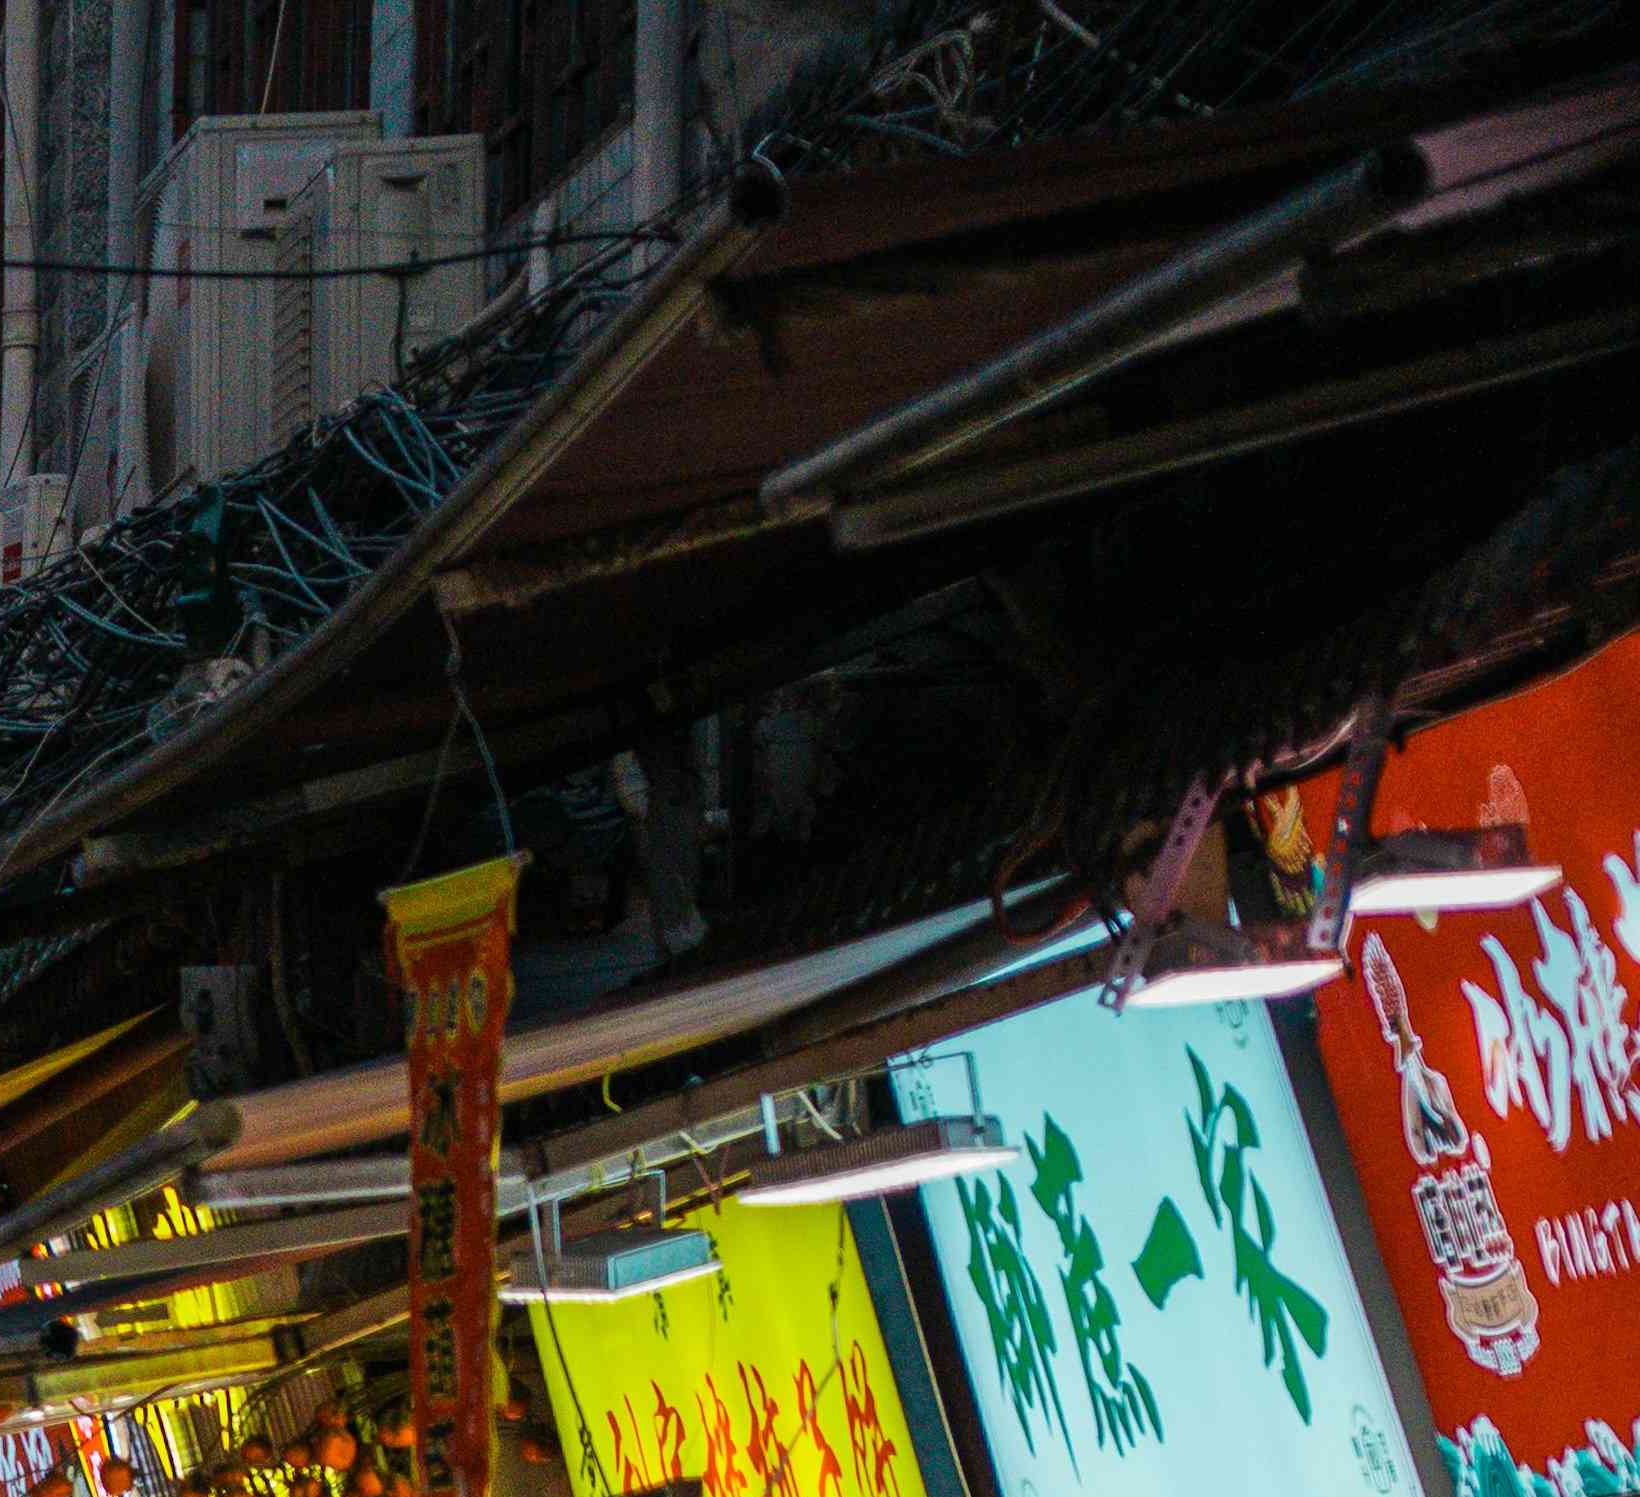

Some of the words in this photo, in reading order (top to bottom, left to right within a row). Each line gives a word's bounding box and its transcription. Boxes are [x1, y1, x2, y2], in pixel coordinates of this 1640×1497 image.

[956, 1046, 1330, 1484] 椰蔗一家
[1535, 1192, 1640, 1284] BINGT
